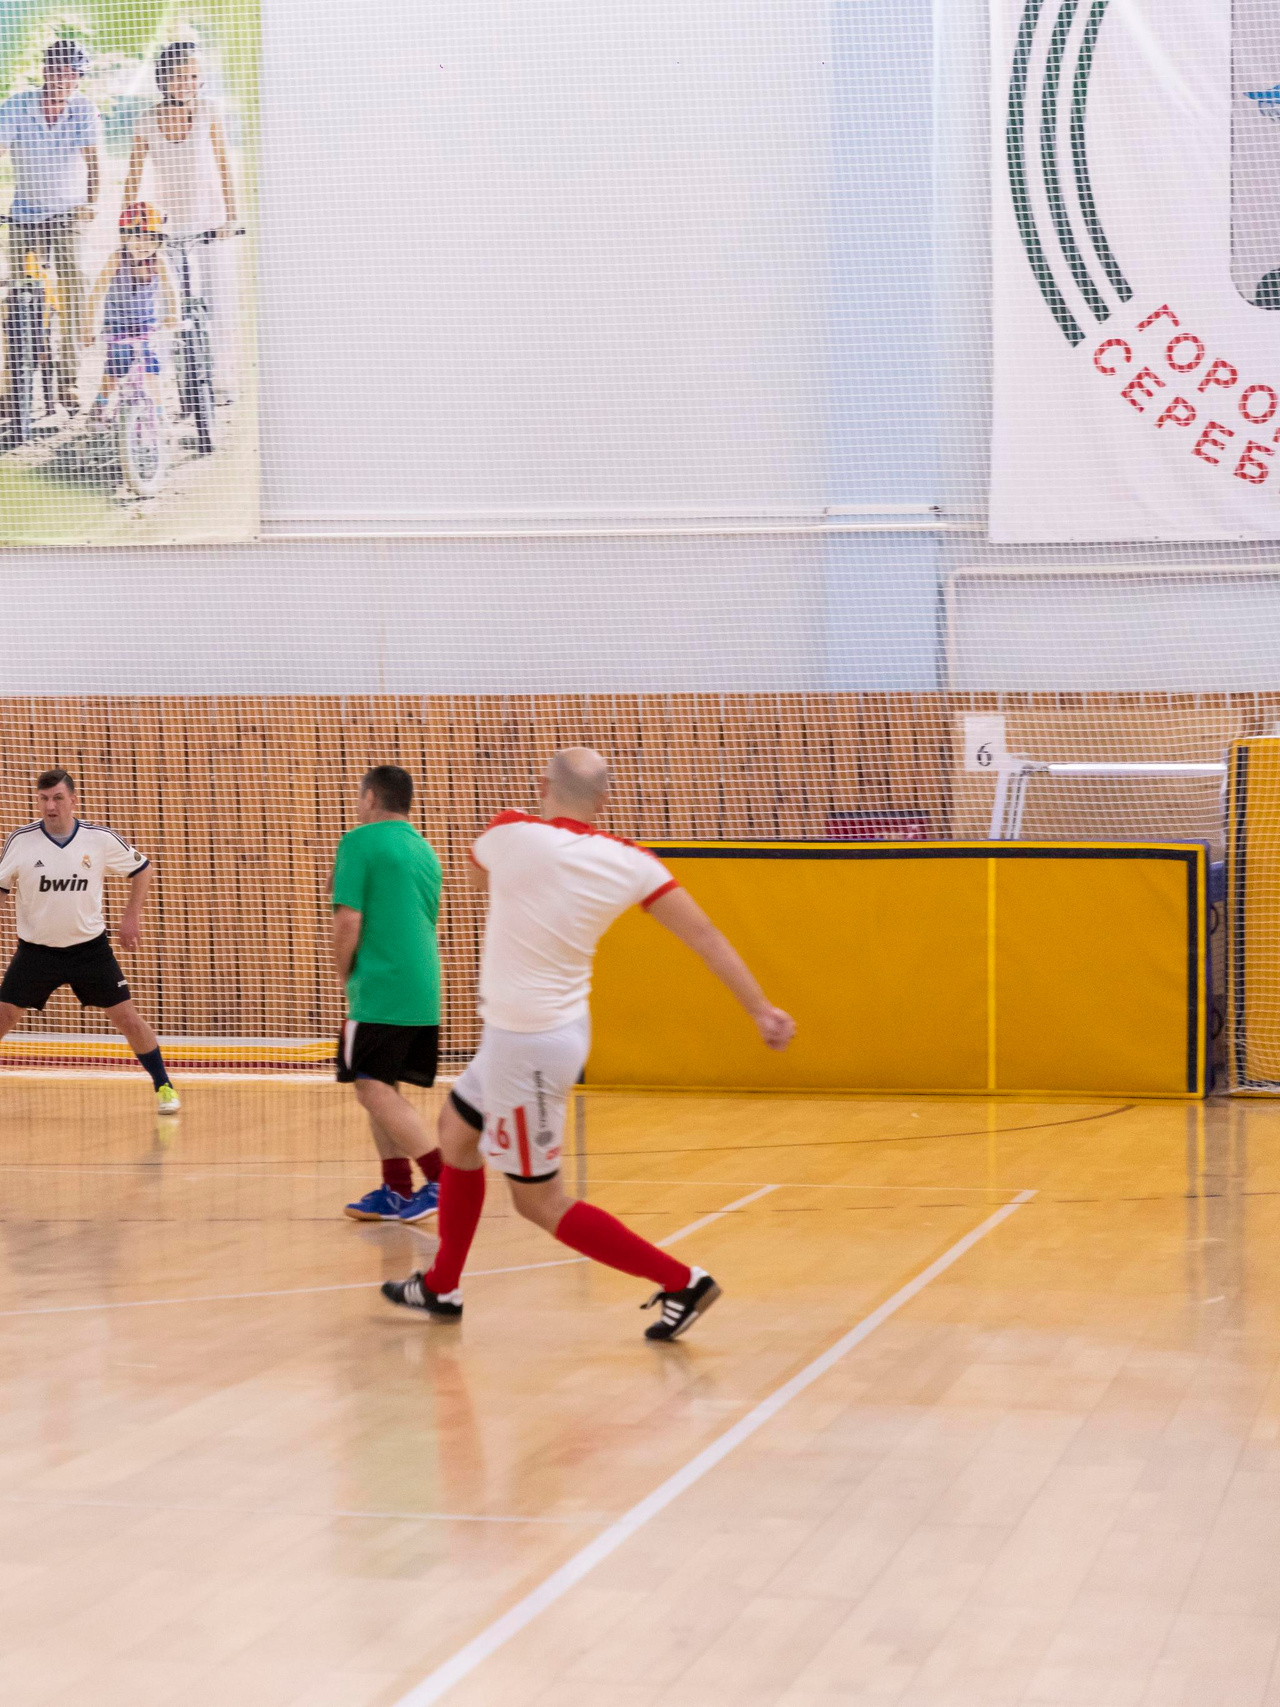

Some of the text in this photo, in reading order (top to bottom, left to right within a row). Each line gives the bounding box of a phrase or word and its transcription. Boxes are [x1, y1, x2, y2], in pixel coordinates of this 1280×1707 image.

[1094, 338, 1278, 485] СЕРЕБ
[1136, 304, 1280, 443] ГОРО
[976, 742, 992, 767] 6
[39, 874, 89, 893] bwin
